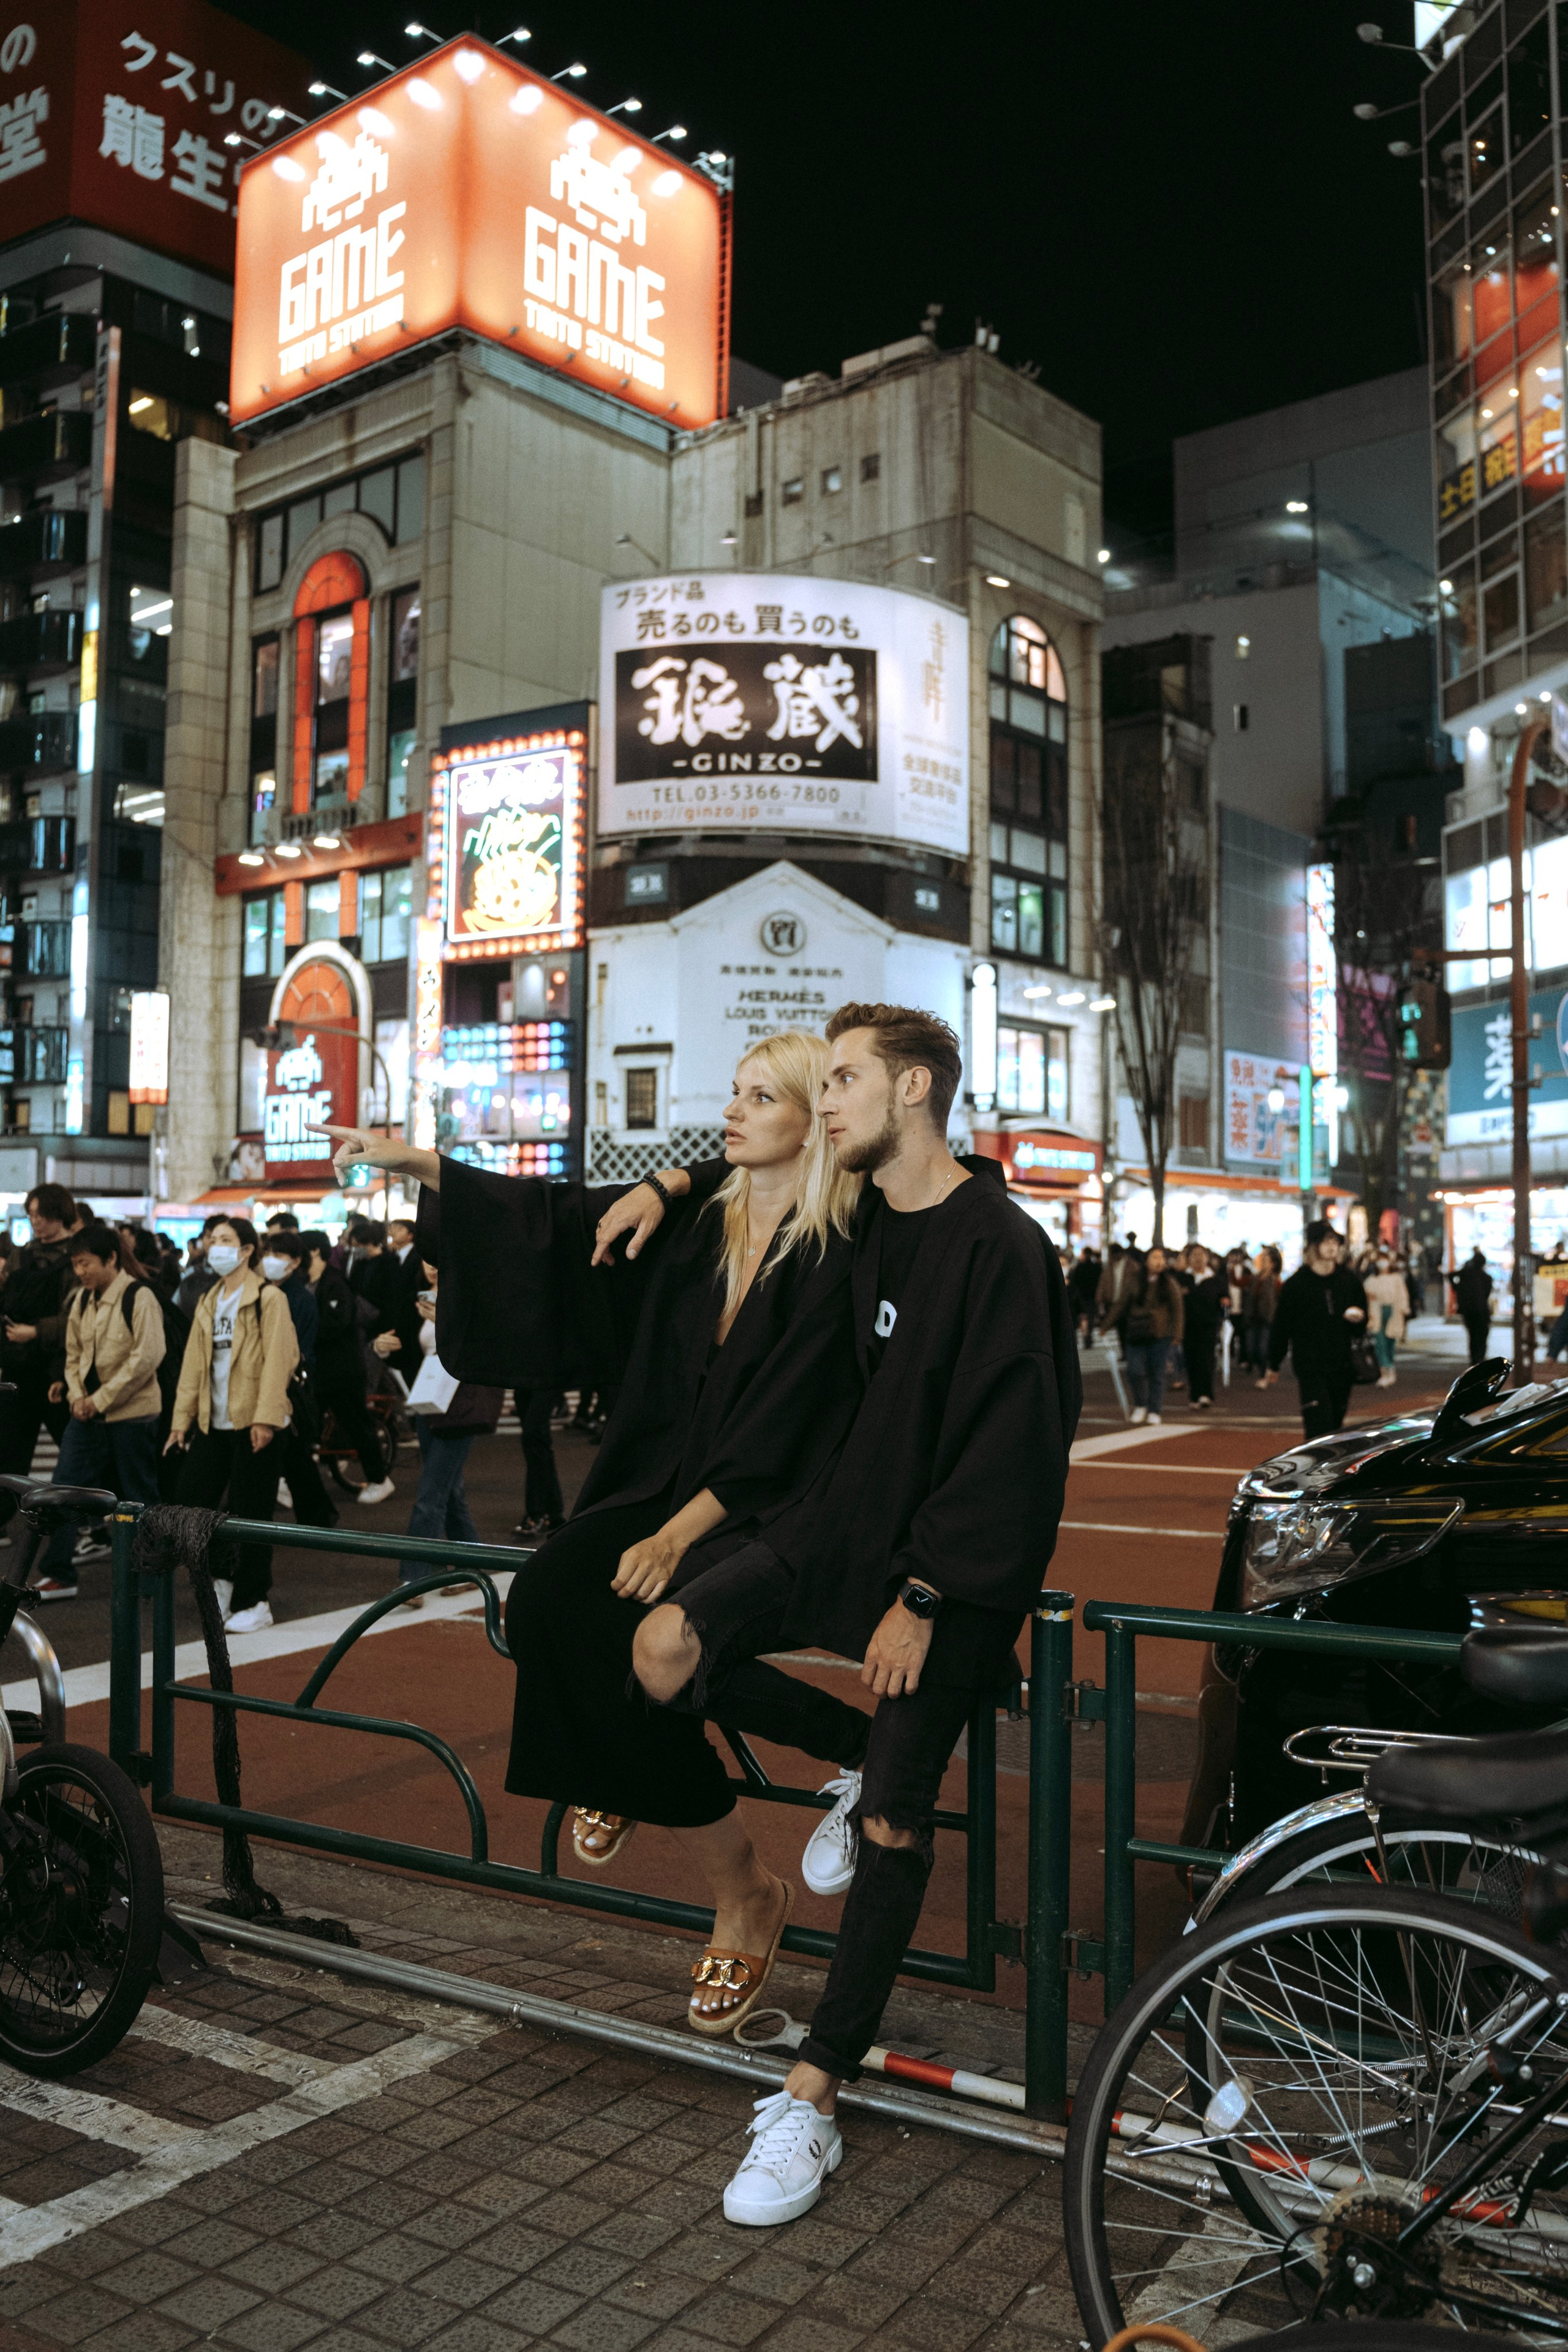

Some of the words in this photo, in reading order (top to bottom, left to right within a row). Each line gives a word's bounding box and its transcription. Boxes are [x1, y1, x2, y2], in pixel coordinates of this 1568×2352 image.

[119, 30, 282, 138] クスリの
[98, 92, 239, 217] 龍生
[278, 201, 406, 344] GAME
[524, 205, 665, 357] GAME
[616, 580, 706, 609] ブランド品
[725, 1007, 767, 1020] LOUIS
[264, 1090, 333, 1144] GAME
